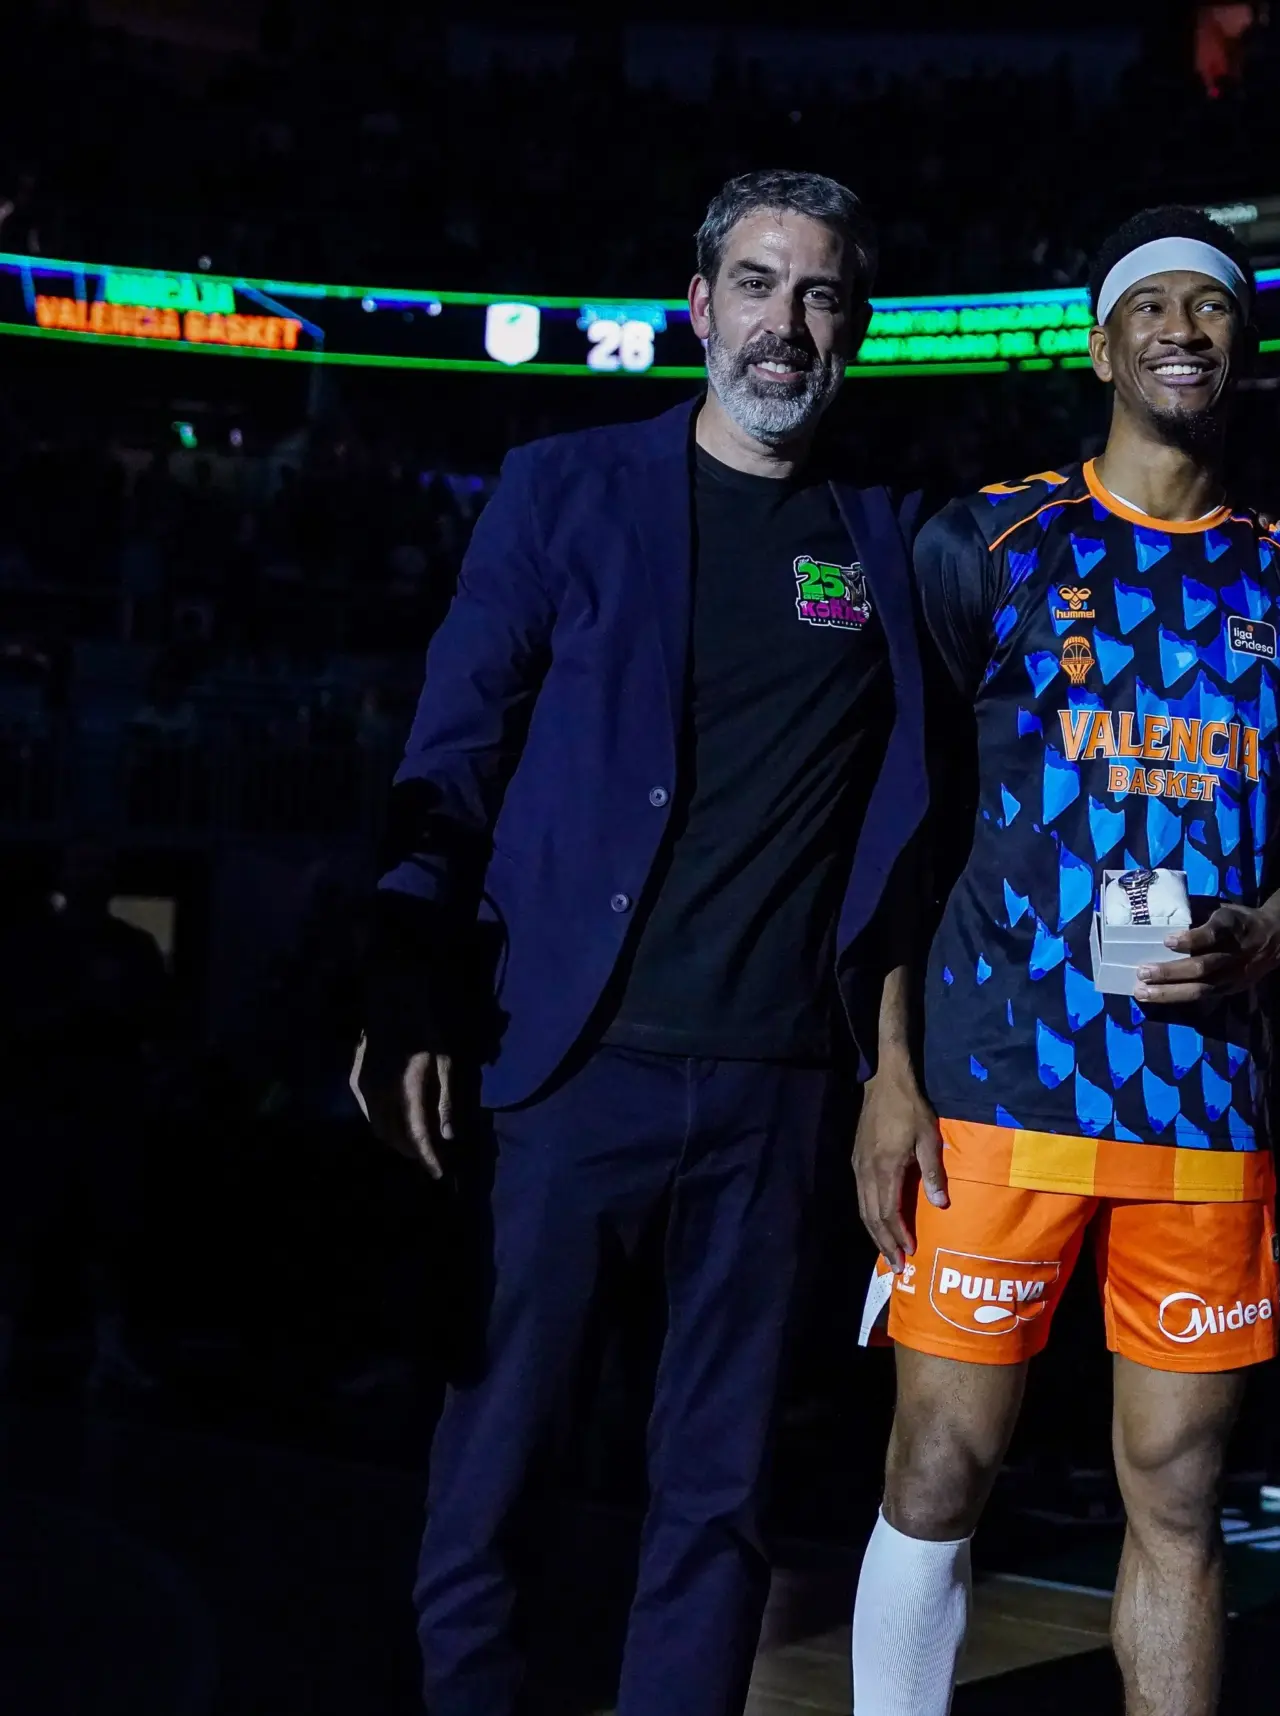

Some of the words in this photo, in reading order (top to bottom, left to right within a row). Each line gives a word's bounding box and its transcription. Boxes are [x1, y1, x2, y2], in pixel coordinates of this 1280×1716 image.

[798, 561, 846, 598] 25
[1055, 608, 1096, 620] hummel
[1233, 627, 1253, 640] liga
[1234, 638, 1274, 655] endesa
[1058, 709, 1260, 782] VALENCIA
[1107, 764, 1220, 802] BASKET
[938, 1267, 1045, 1302] PULEVA
[1177, 1297, 1272, 1337] Midea
